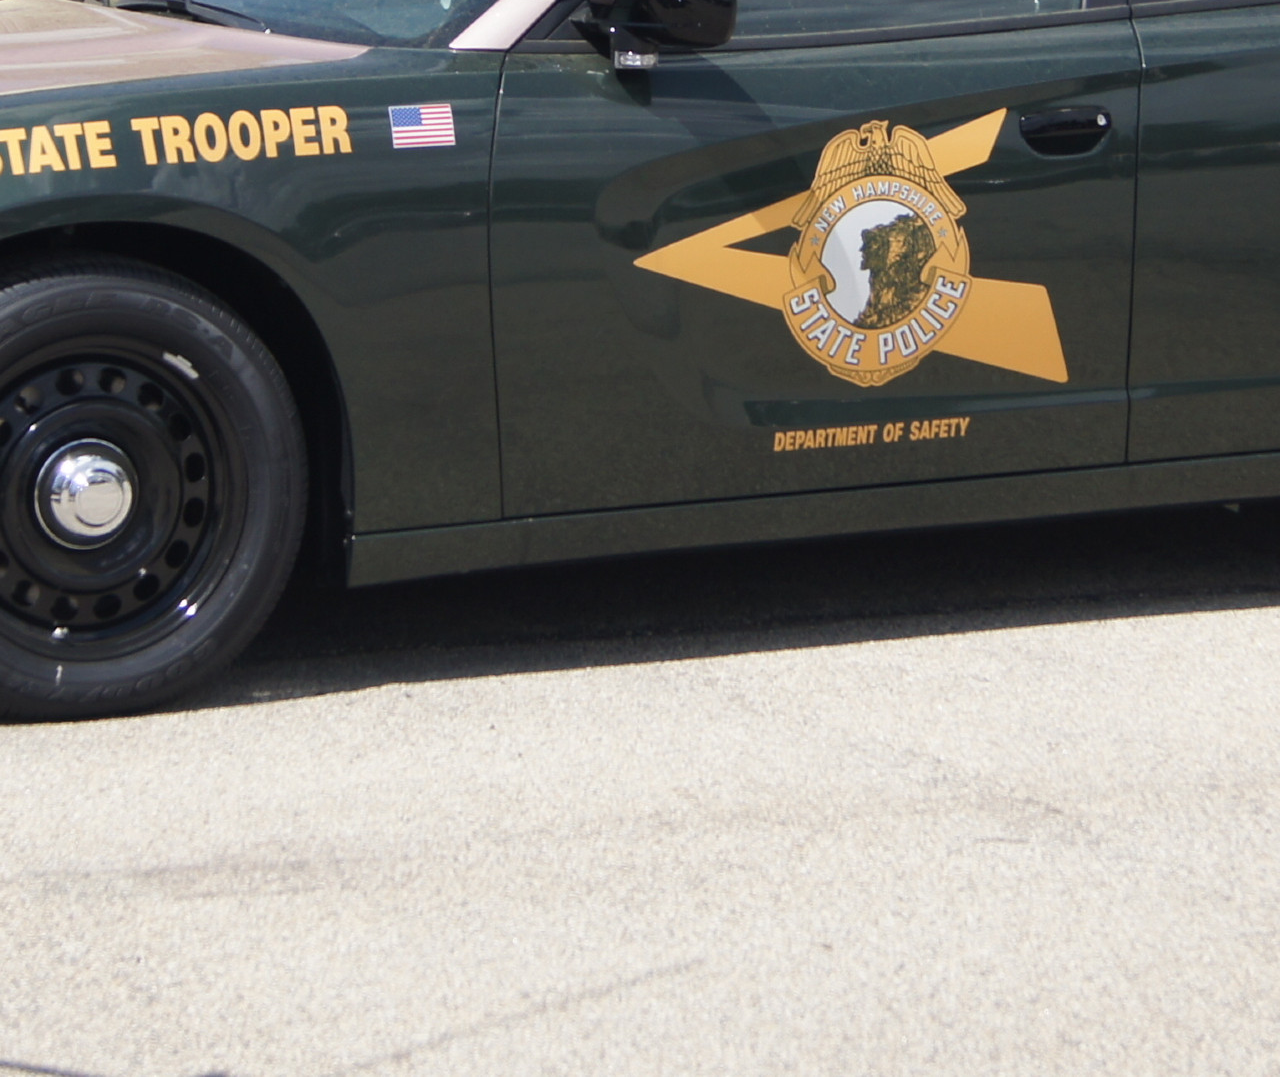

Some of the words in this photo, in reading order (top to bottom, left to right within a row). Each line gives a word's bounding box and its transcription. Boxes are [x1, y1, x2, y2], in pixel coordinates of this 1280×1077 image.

[131, 104, 352, 166] TROOPER
[815, 195, 847, 232] NEW
[852, 180, 945, 225] HAMPSHIRE
[788, 287, 867, 365] STATE
[878, 274, 970, 365] POLICE
[773, 424, 878, 452] DEPARTMENT
[883, 422, 904, 443] OF
[909, 417, 971, 441] SAFETY
